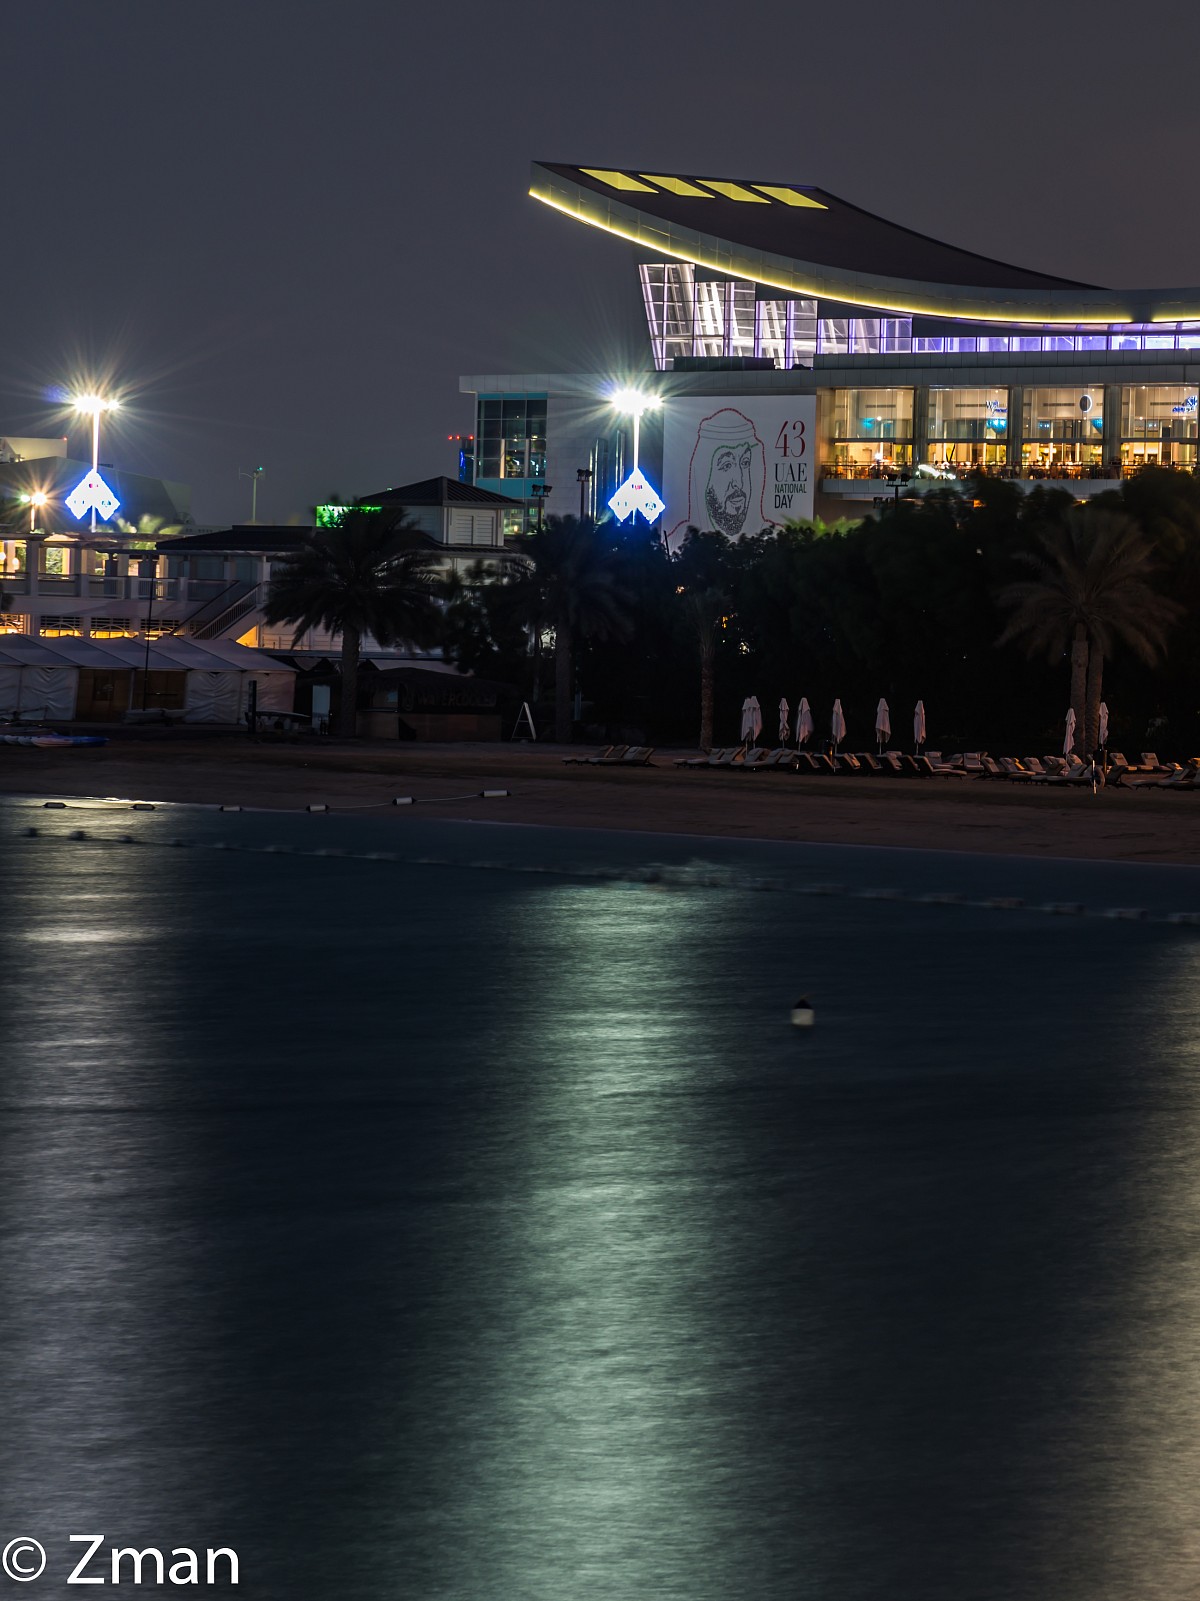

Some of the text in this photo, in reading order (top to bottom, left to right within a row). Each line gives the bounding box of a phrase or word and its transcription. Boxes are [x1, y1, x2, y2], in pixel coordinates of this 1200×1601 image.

[774, 420, 806, 458] 43
[774, 462, 808, 482] UAE
[774, 483, 807, 494] NATIONAL
[774, 494, 794, 509] DAY
